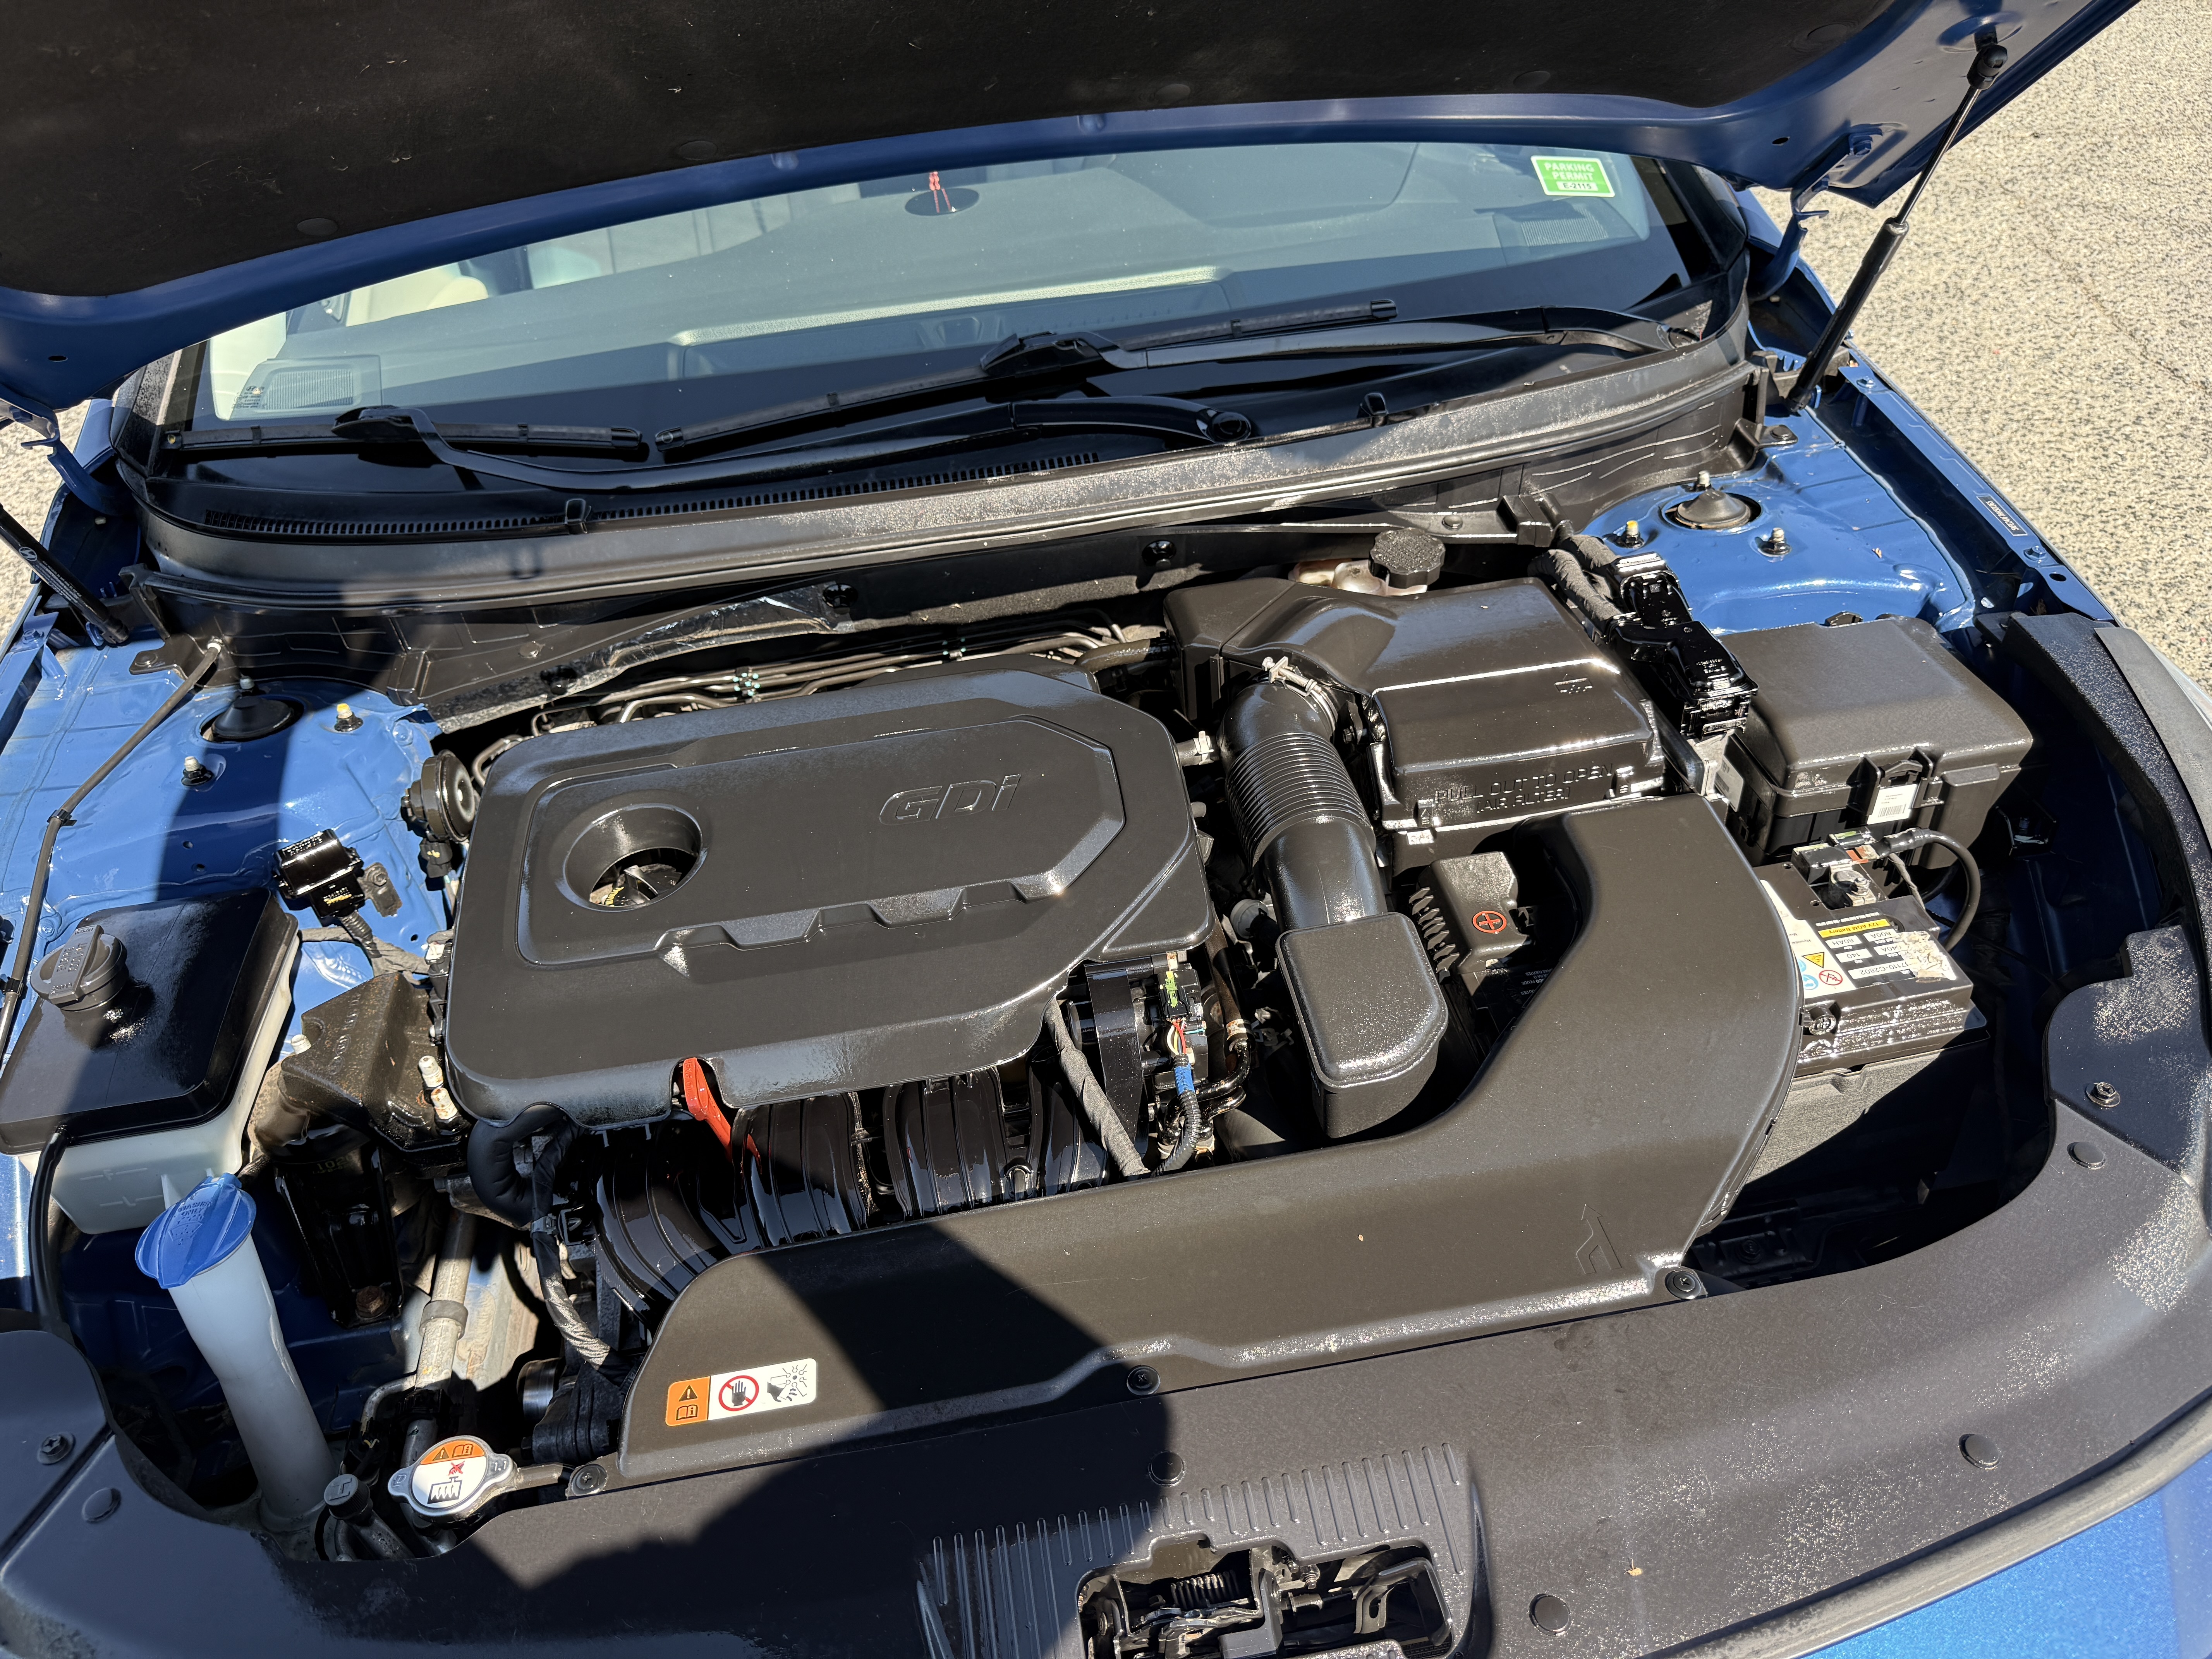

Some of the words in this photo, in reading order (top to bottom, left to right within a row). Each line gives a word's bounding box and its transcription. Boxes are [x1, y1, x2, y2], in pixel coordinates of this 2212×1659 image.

[1544, 162, 1595, 172] PARKING
[1551, 171, 1593, 181] PERMIT
[1435, 785, 1483, 804] PULL
[1489, 778, 1528, 795] OUT
[1532, 773, 1556, 789] TO
[1562, 763, 1613, 784] OPEN
